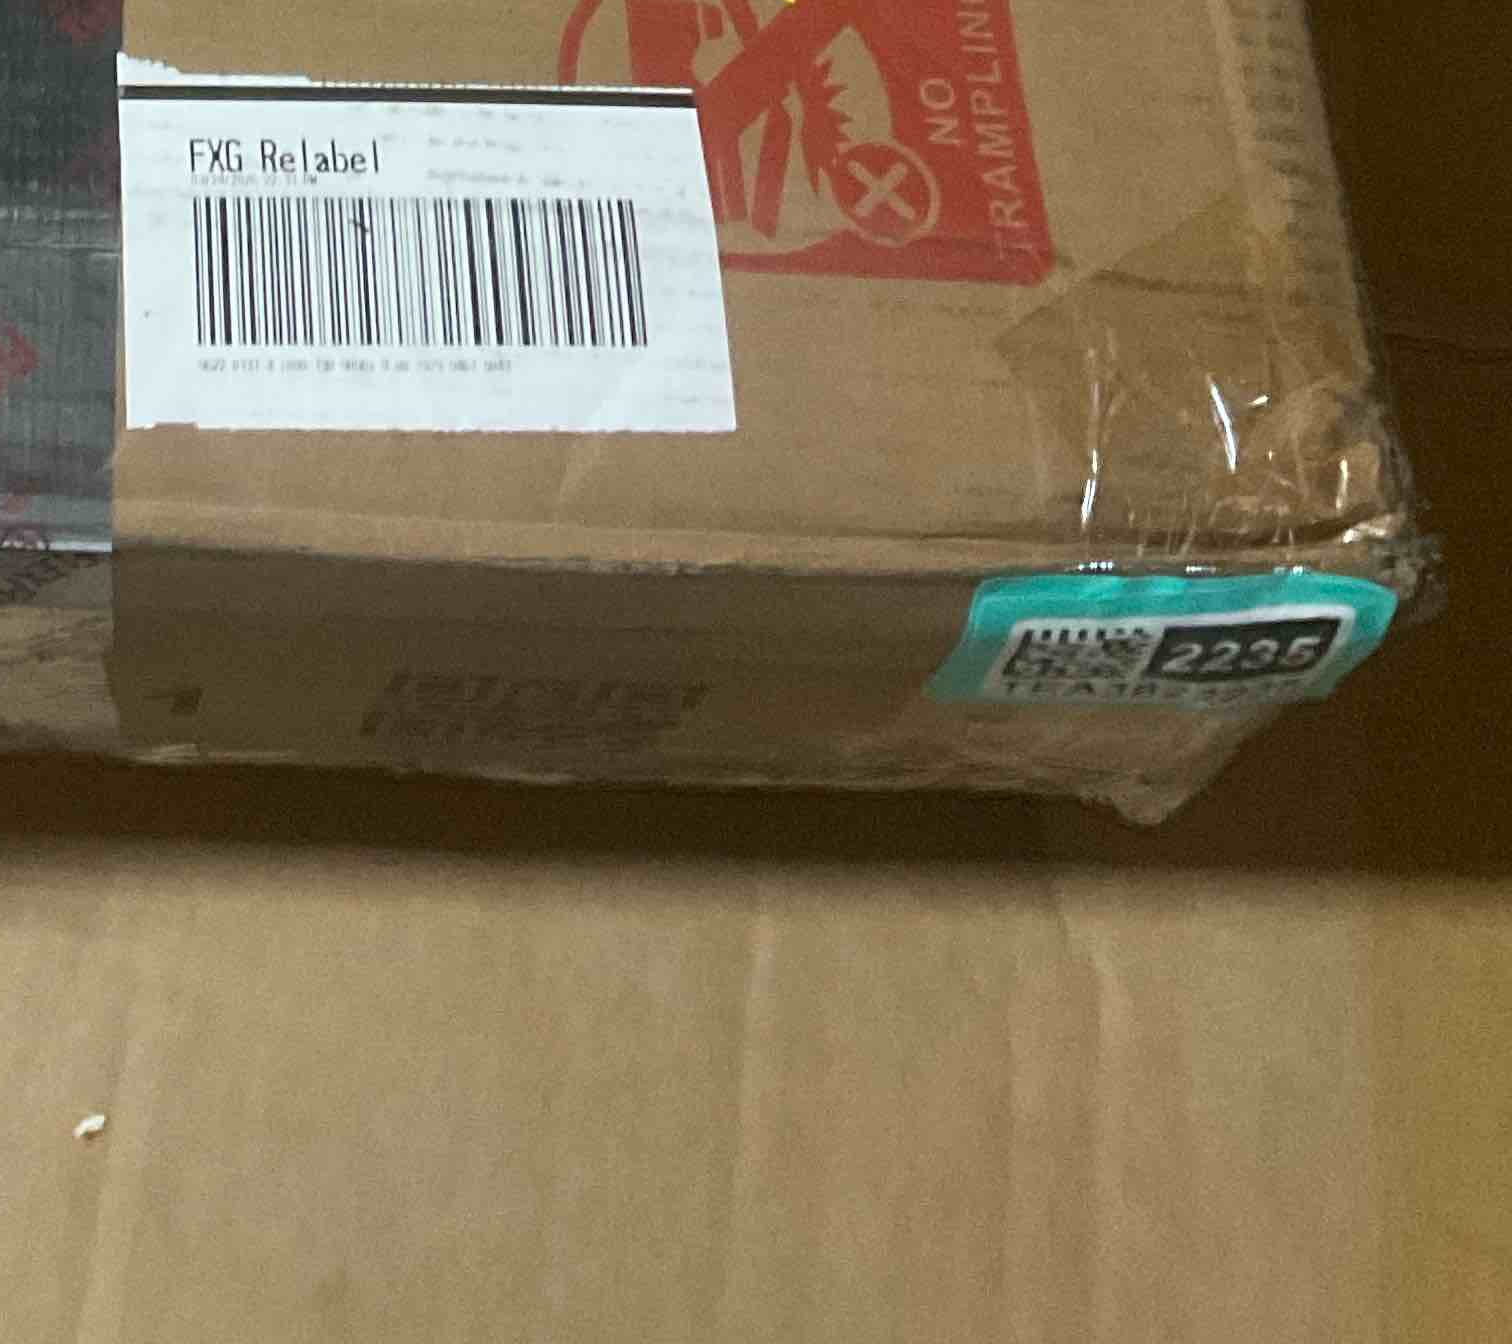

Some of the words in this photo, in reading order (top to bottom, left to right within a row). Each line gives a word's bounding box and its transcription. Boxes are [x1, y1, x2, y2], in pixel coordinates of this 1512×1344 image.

[919, 77, 964, 147] NO
[189, 138, 243, 173] FXG
[260, 137, 379, 174] Relabel
